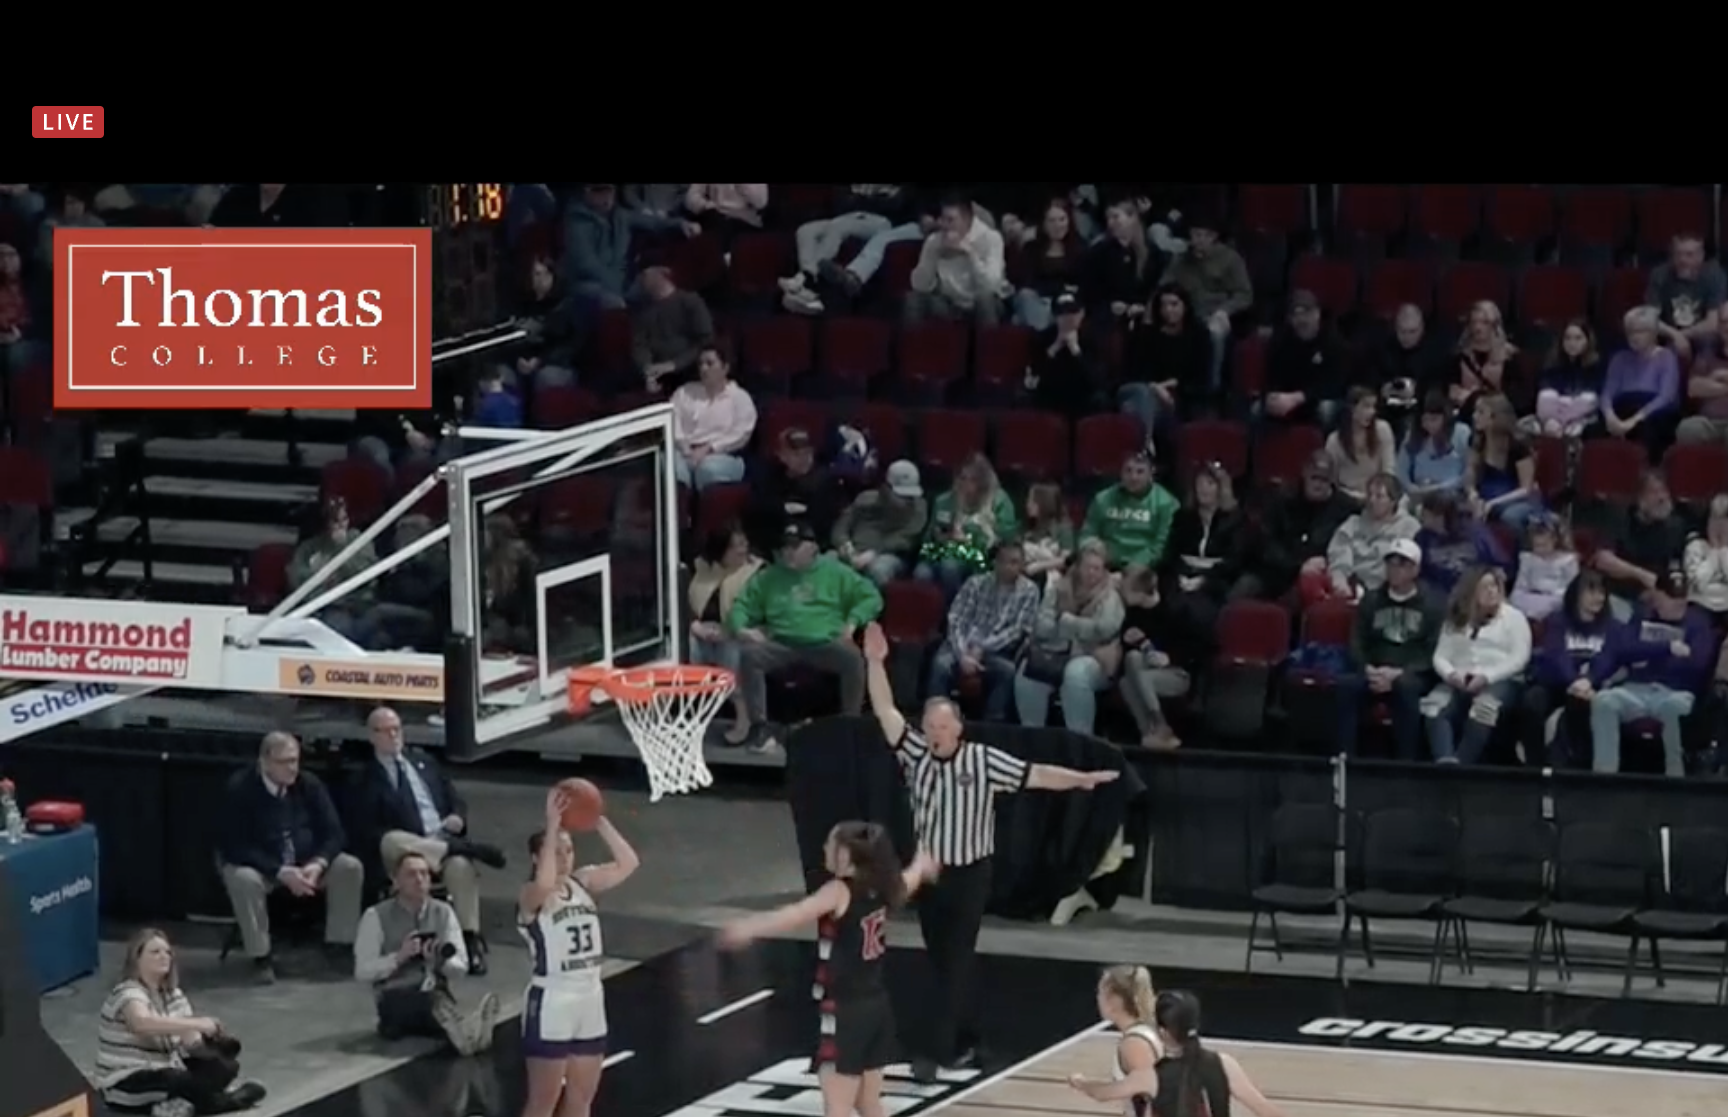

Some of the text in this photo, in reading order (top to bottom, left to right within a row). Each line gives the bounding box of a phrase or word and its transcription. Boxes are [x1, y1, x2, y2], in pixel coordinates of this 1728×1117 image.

[2, 609, 192, 649] Hammond
[2, 648, 187, 679] Lumber Company
[373, 672, 403, 686] AUTO
[29, 875, 93, 915] Sports Health
[566, 924, 593, 955] 33
